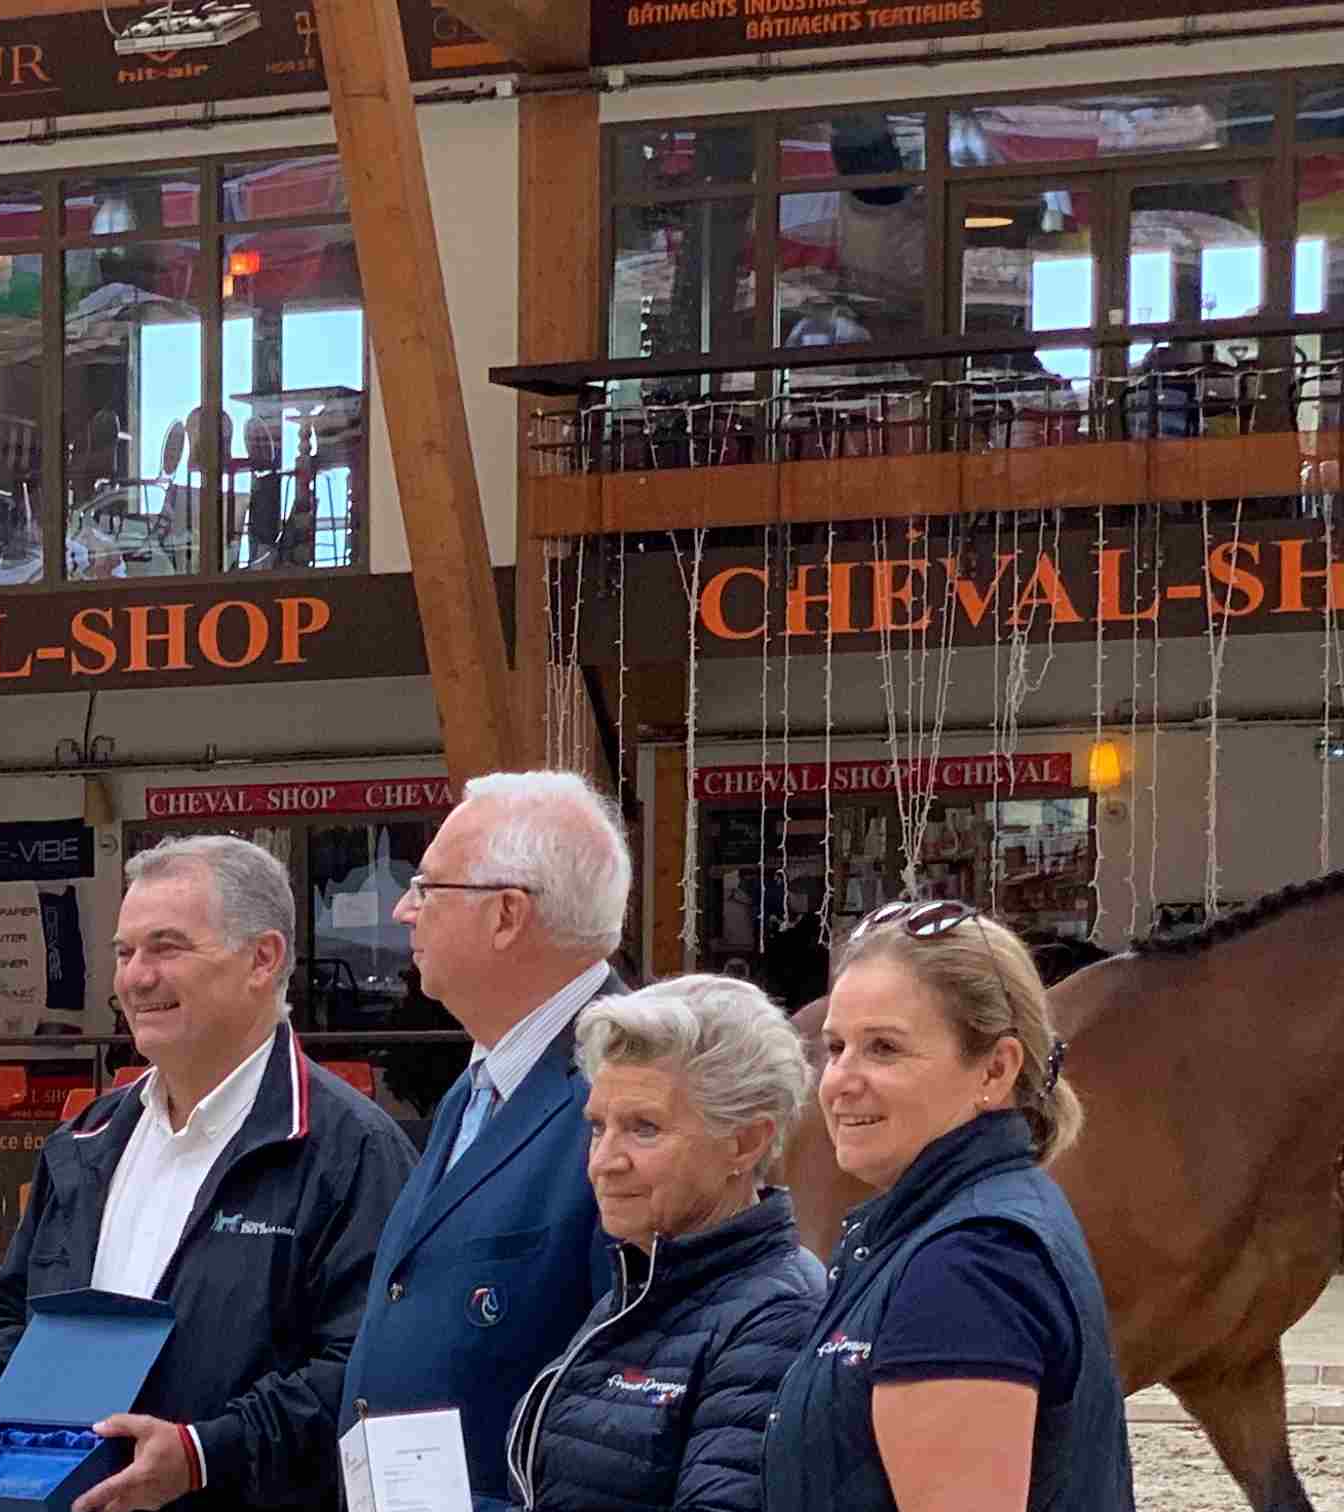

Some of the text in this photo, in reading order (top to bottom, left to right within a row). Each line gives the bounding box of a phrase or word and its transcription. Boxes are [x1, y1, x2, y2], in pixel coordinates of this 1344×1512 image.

[745, 0, 983, 40] BÂTIMENTS TERTIAIRES
[703, 759, 1061, 795] CHEVAL SHOP CHEVAL
[148, 782, 454, 816] CHEVAL SHOP CHEVA
